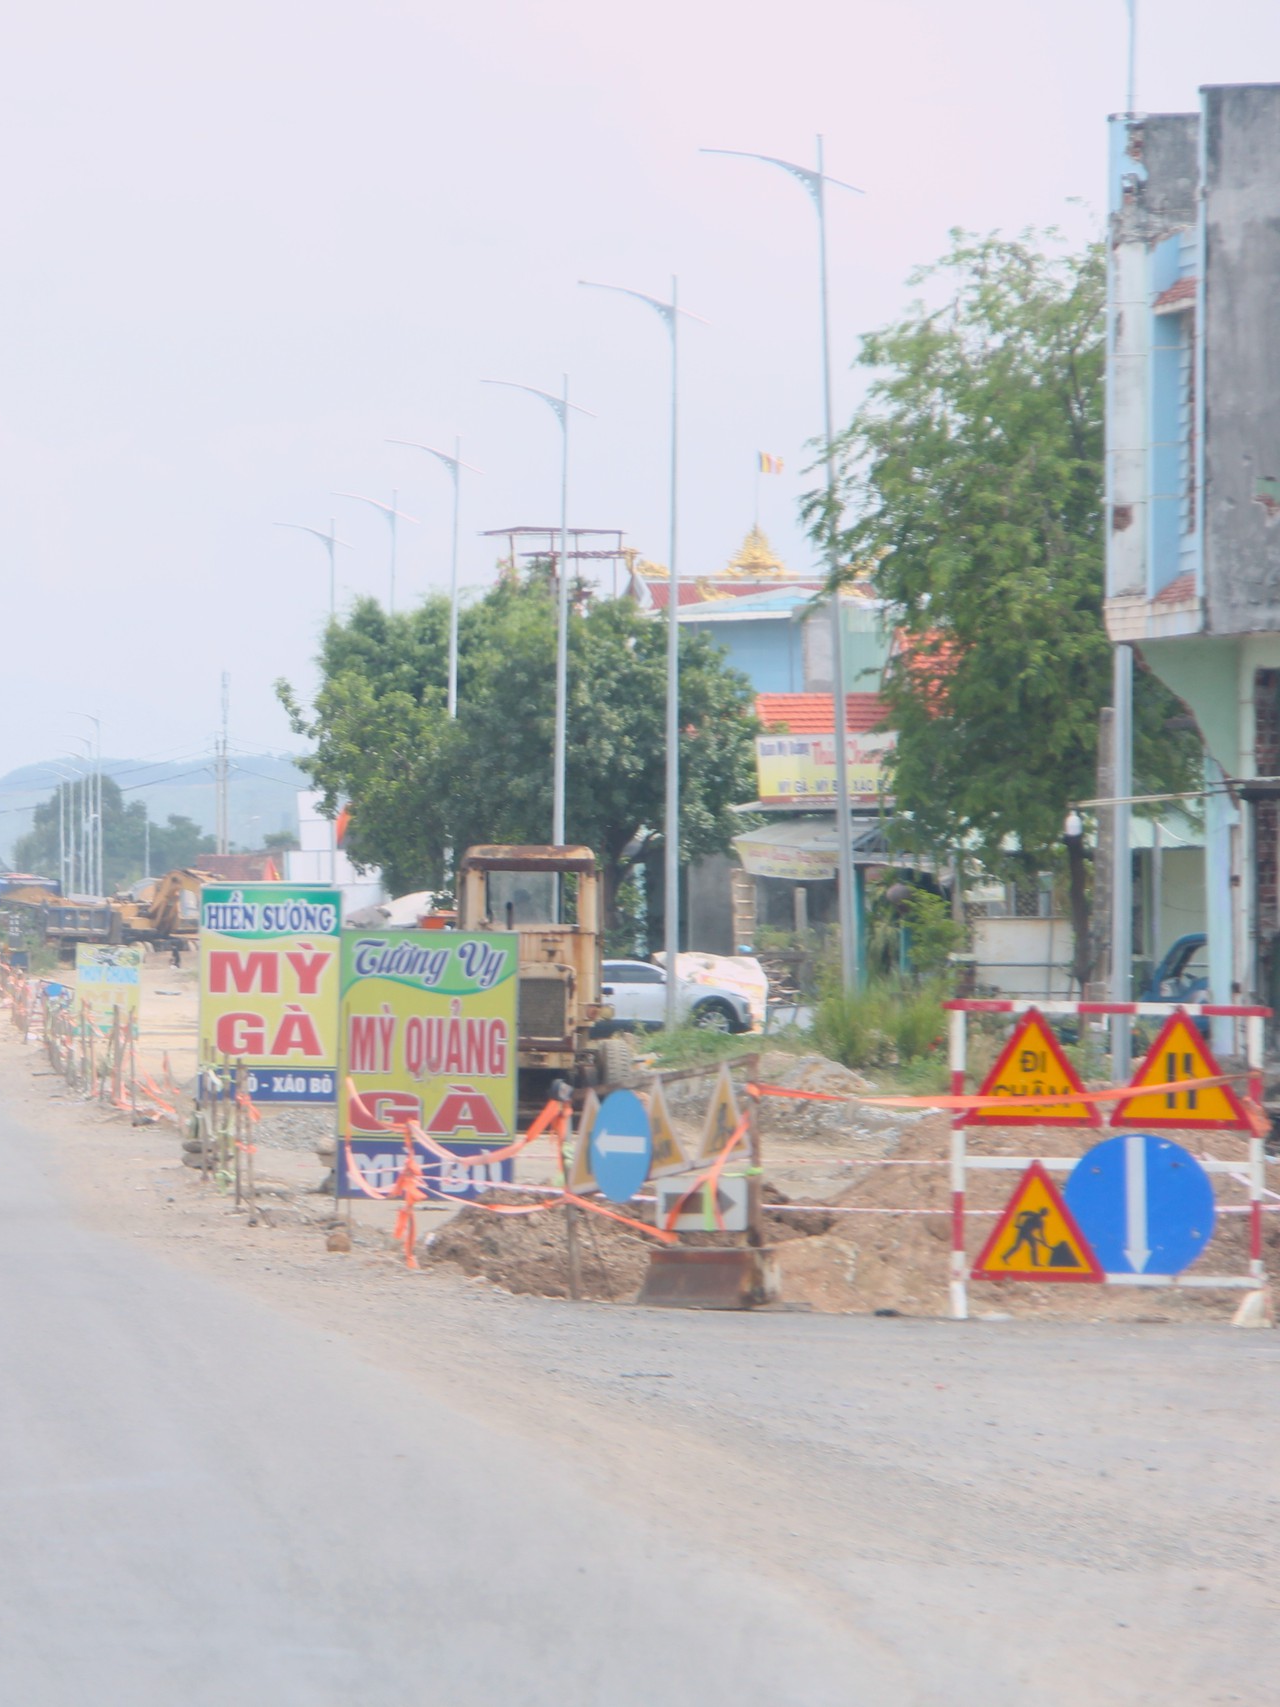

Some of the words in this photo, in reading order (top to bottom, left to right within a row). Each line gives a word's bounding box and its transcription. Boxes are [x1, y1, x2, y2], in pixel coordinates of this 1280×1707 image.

[206, 891, 257, 931] HIỀN
[209, 942, 332, 994] MỲ
[216, 1004, 324, 1057] GÀ
[349, 1003, 396, 1073] MỲ
[404, 998, 509, 1081] QUẢNG
[310, 1073, 333, 1094] BÒ
[1020, 1050, 1048, 1074] ĐI
[350, 1084, 507, 1135] GÀ
